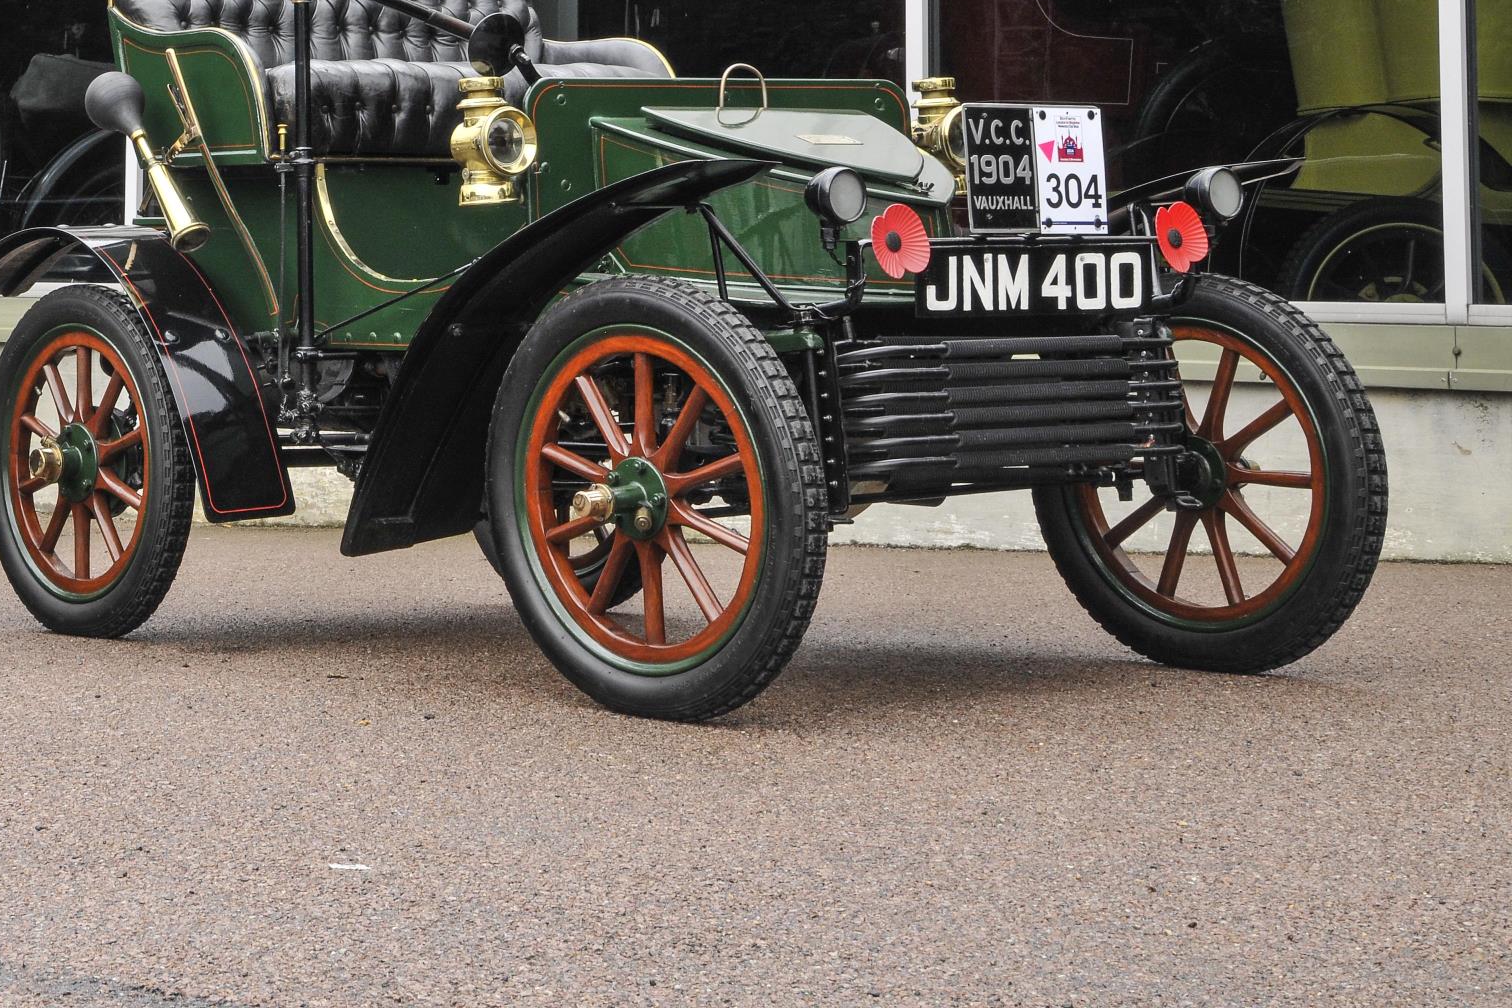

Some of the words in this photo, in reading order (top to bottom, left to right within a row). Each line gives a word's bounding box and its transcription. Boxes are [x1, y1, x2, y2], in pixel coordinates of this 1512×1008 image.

[968, 118, 1030, 145] V.C.C.
[970, 154, 1033, 185] 1904
[973, 194, 1034, 211] VAUXHALL
[1045, 173, 1103, 209] 304
[926, 253, 1029, 311] JNM
[1041, 252, 1142, 310] 400
